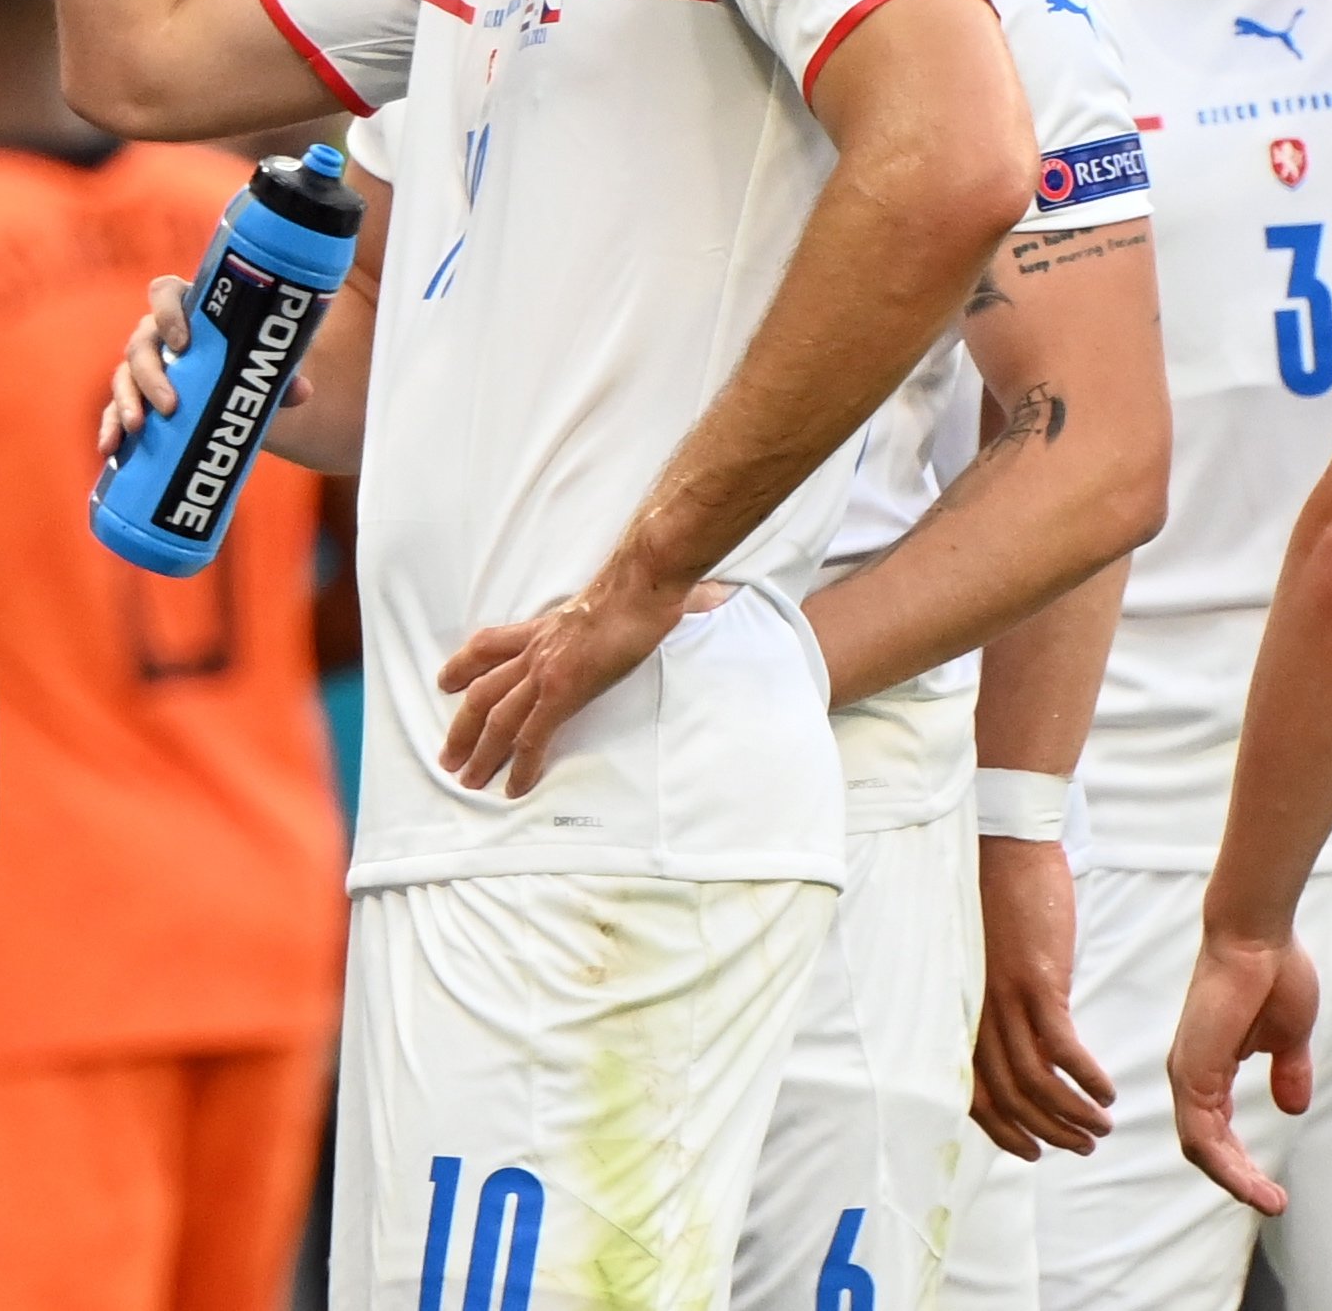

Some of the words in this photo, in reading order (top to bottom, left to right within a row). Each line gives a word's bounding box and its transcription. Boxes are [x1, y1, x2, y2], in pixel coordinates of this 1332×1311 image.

[207, 276, 233, 318] CZE
[172, 283, 313, 532] POWERADE
[419, 1155, 545, 1311] 10
